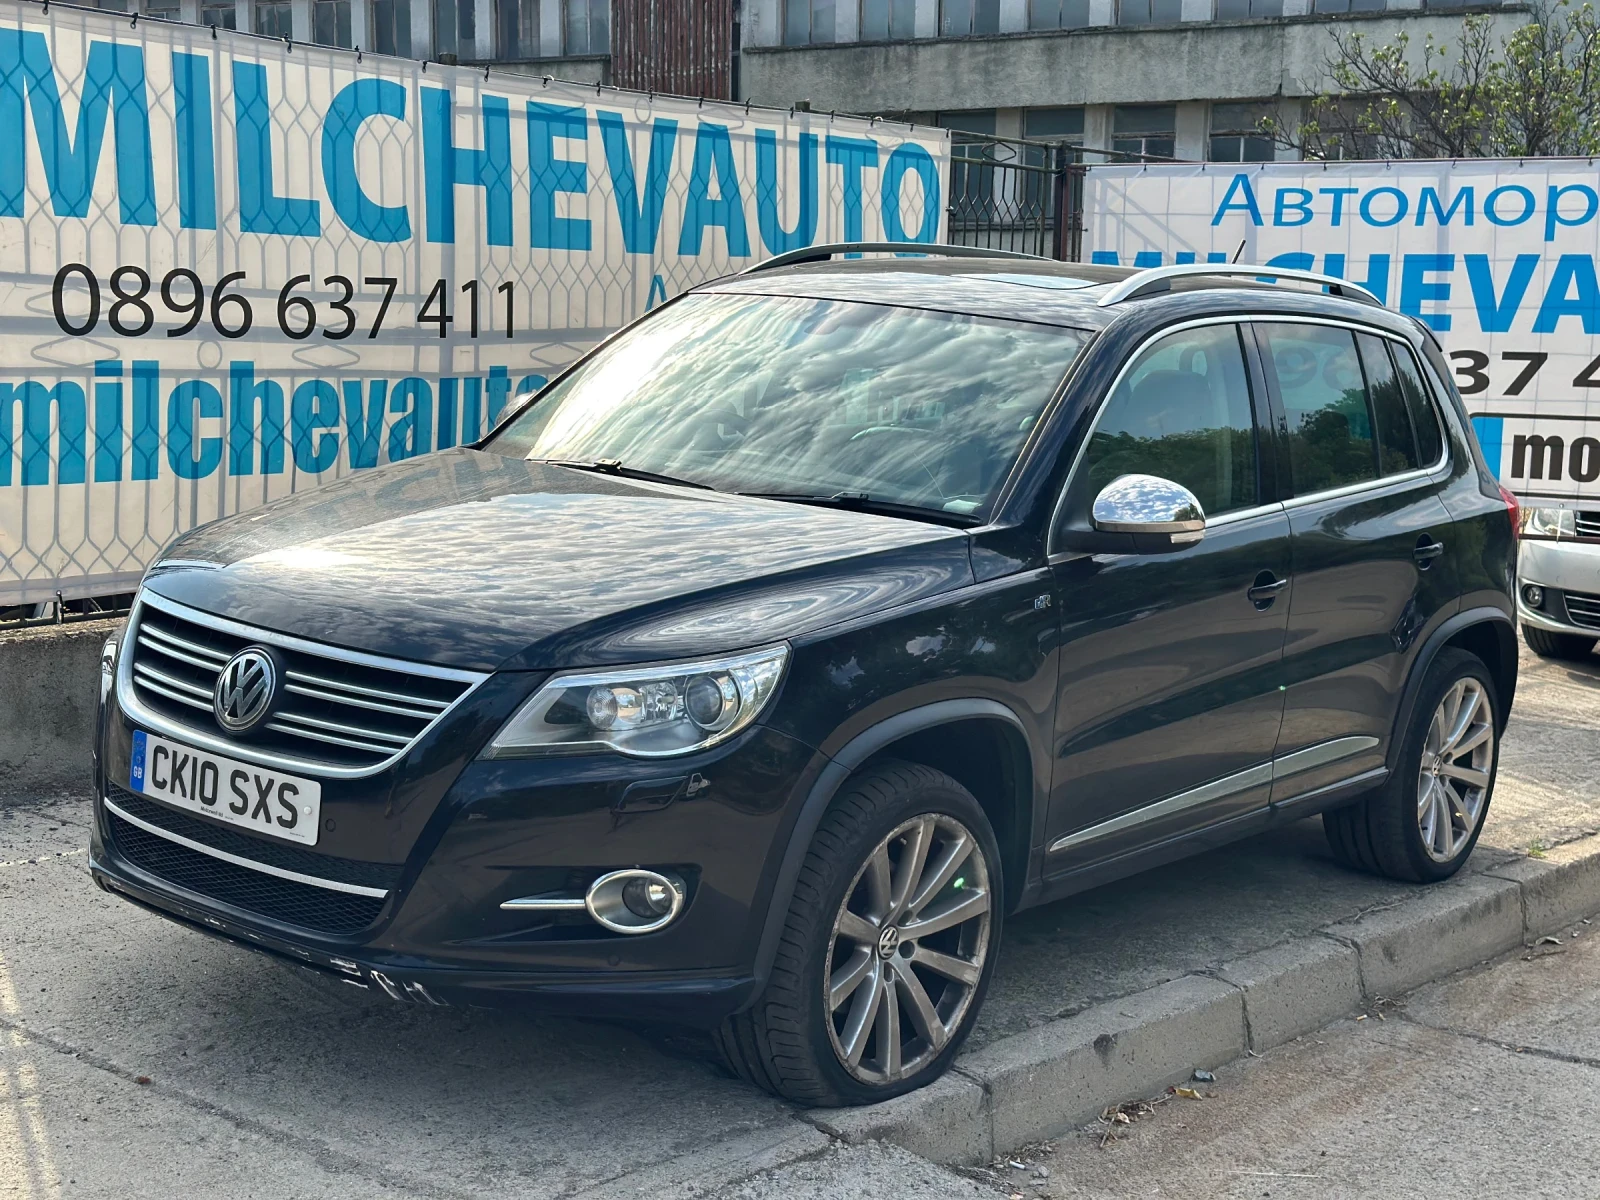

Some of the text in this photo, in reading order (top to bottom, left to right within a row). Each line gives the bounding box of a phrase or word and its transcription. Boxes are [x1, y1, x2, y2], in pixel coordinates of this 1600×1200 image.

[0, 27, 941, 259] MILCHEVAUTO
[1211, 172, 1599, 242] Автомор
[52, 263, 515, 340] 0896 637 411
[1511, 434, 1600, 483] mo
[133, 765, 143, 779] GB
[151, 744, 299, 830] CK10 SXS
